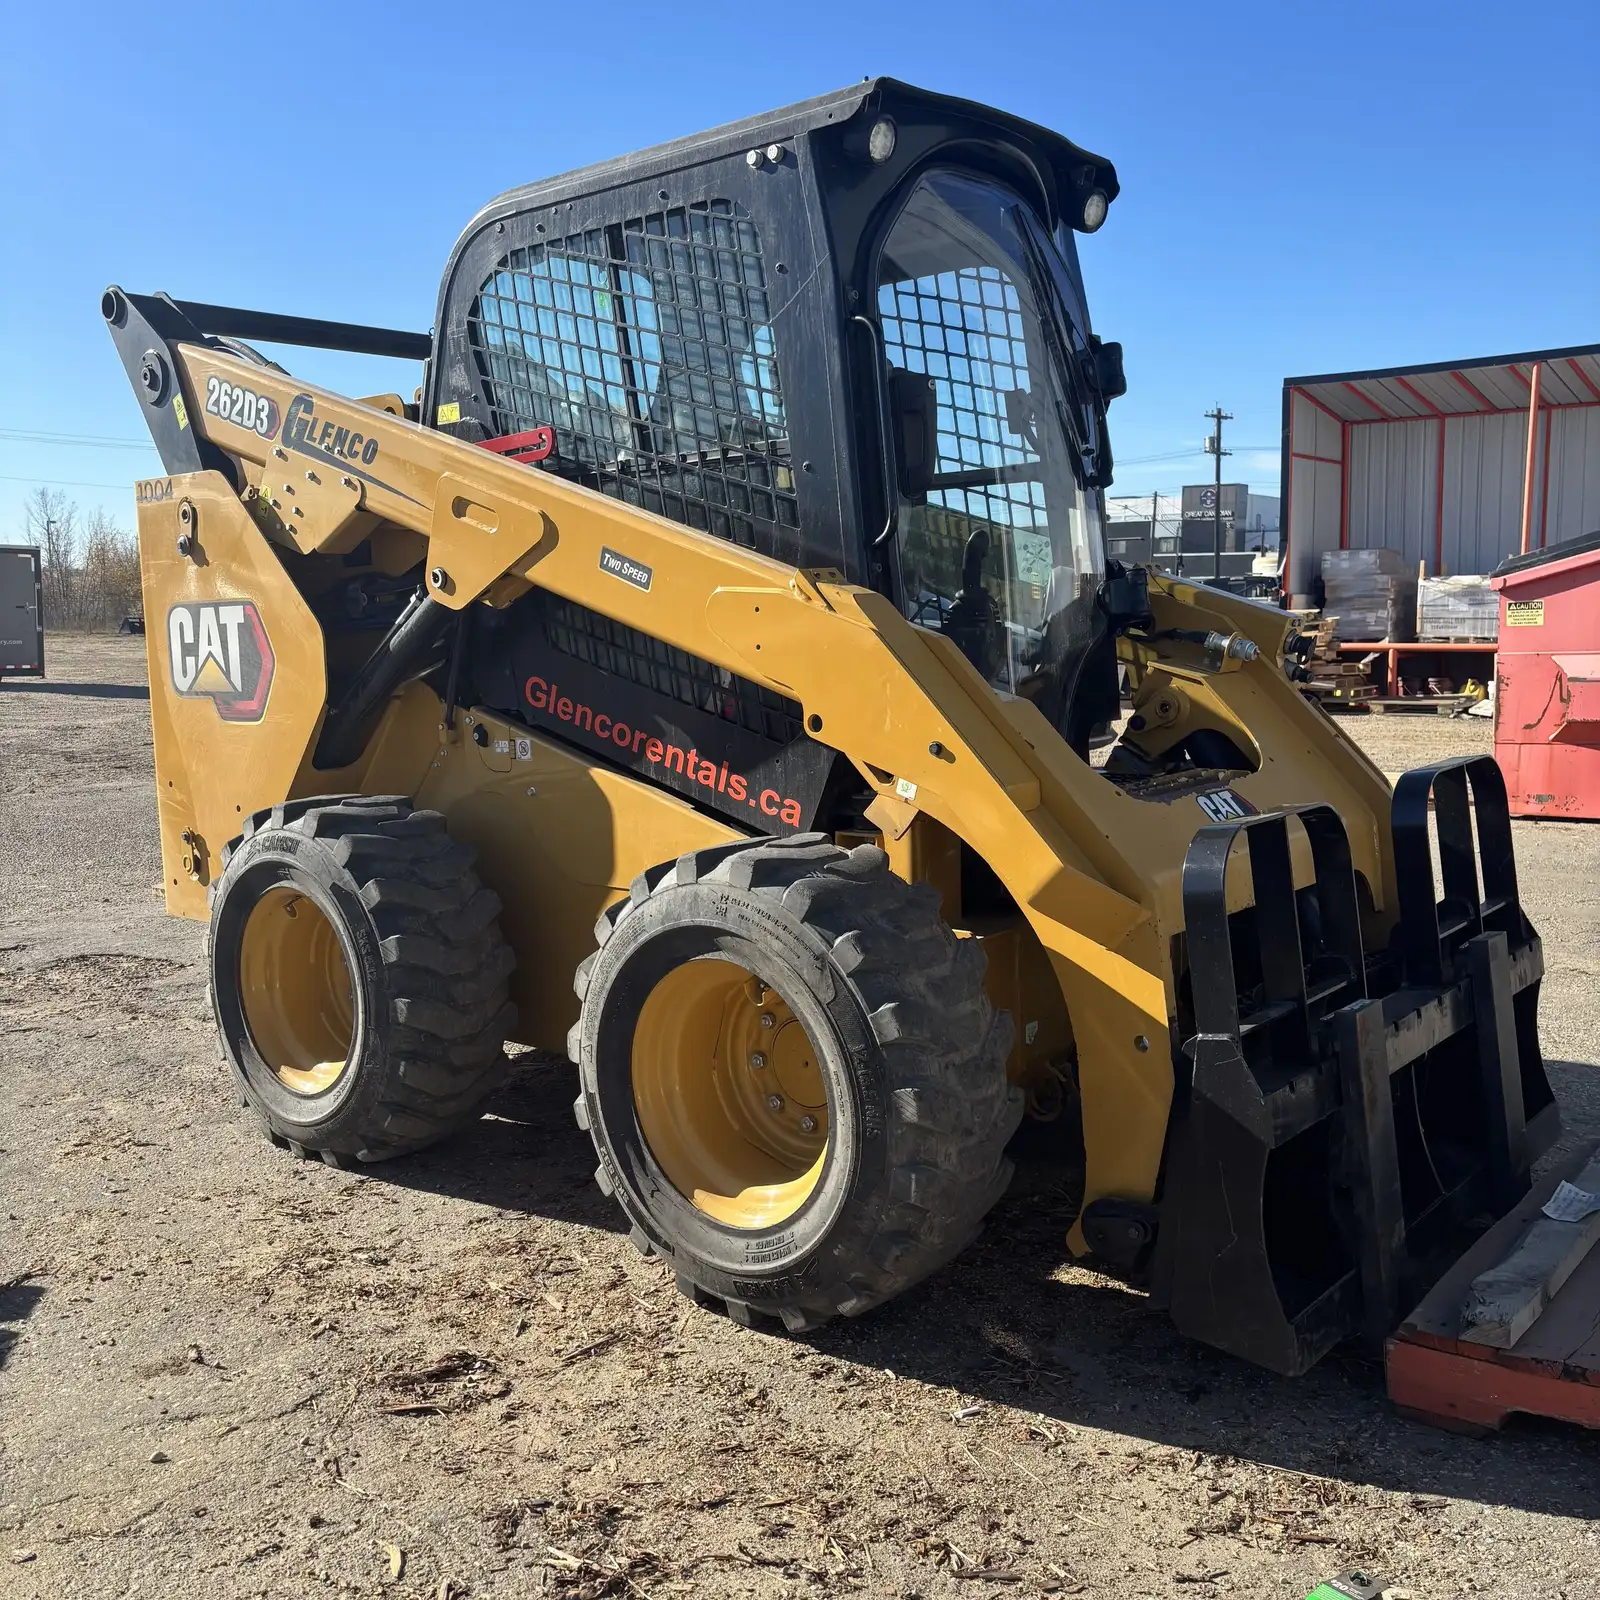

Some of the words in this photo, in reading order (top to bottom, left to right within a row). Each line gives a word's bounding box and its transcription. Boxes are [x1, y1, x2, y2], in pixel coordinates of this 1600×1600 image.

[206, 377, 269, 434] 262D3
[281, 393, 379, 466] GLENCO
[136, 478, 173, 501] 1004
[1184, 510, 1203, 518] GREAT
[603, 553, 622, 571] TWO
[621, 562, 649, 583] SPEED
[1516, 601, 1542, 610] CAUTION
[169, 605, 245, 692] CAT
[525, 676, 802, 828] Glencorentals.ca
[1197, 790, 1245, 822] CAT
